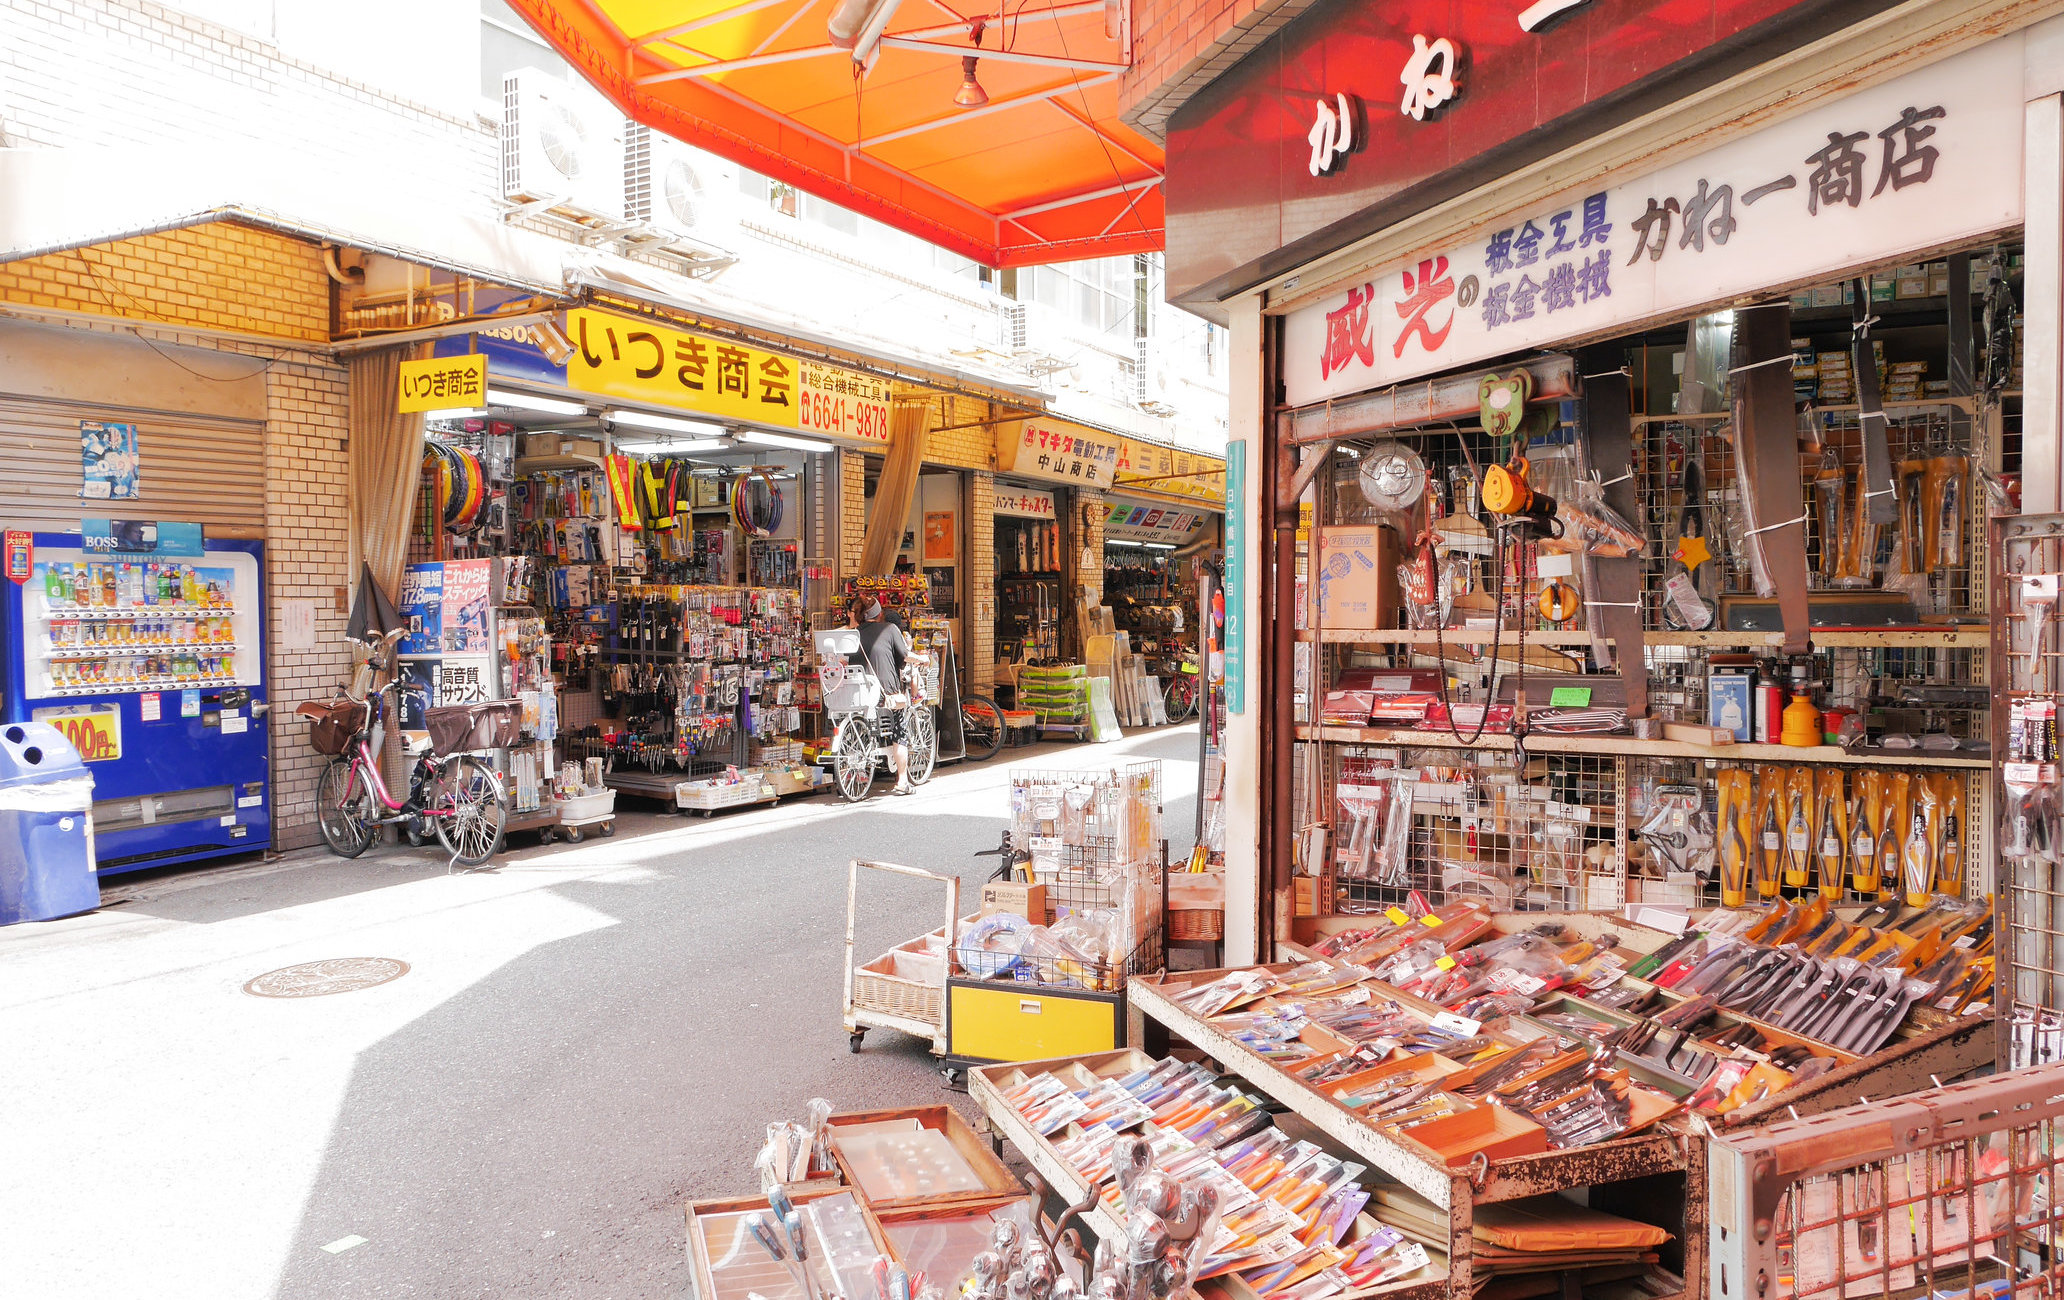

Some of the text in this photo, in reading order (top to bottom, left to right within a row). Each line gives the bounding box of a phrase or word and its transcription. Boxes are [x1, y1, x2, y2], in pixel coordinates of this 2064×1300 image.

[1626, 104, 1946, 267] かね一商店
[579, 316, 790, 407] いつき商会
[403, 367, 478, 398] いつき商会
[809, 372, 882, 401] 総合機械工具
[813, 393, 887, 440] 6641-9878
[1038, 429, 1116, 463] マキタ電動工具
[1038, 454, 1097, 480] 中山商店
[85, 536, 118, 548] BOSS
[1226, 489, 1235, 597] 日本橋四丁目
[444, 567, 490, 584] これからは
[443, 584, 489, 601] スティック
[442, 667, 479, 685] 高音質
